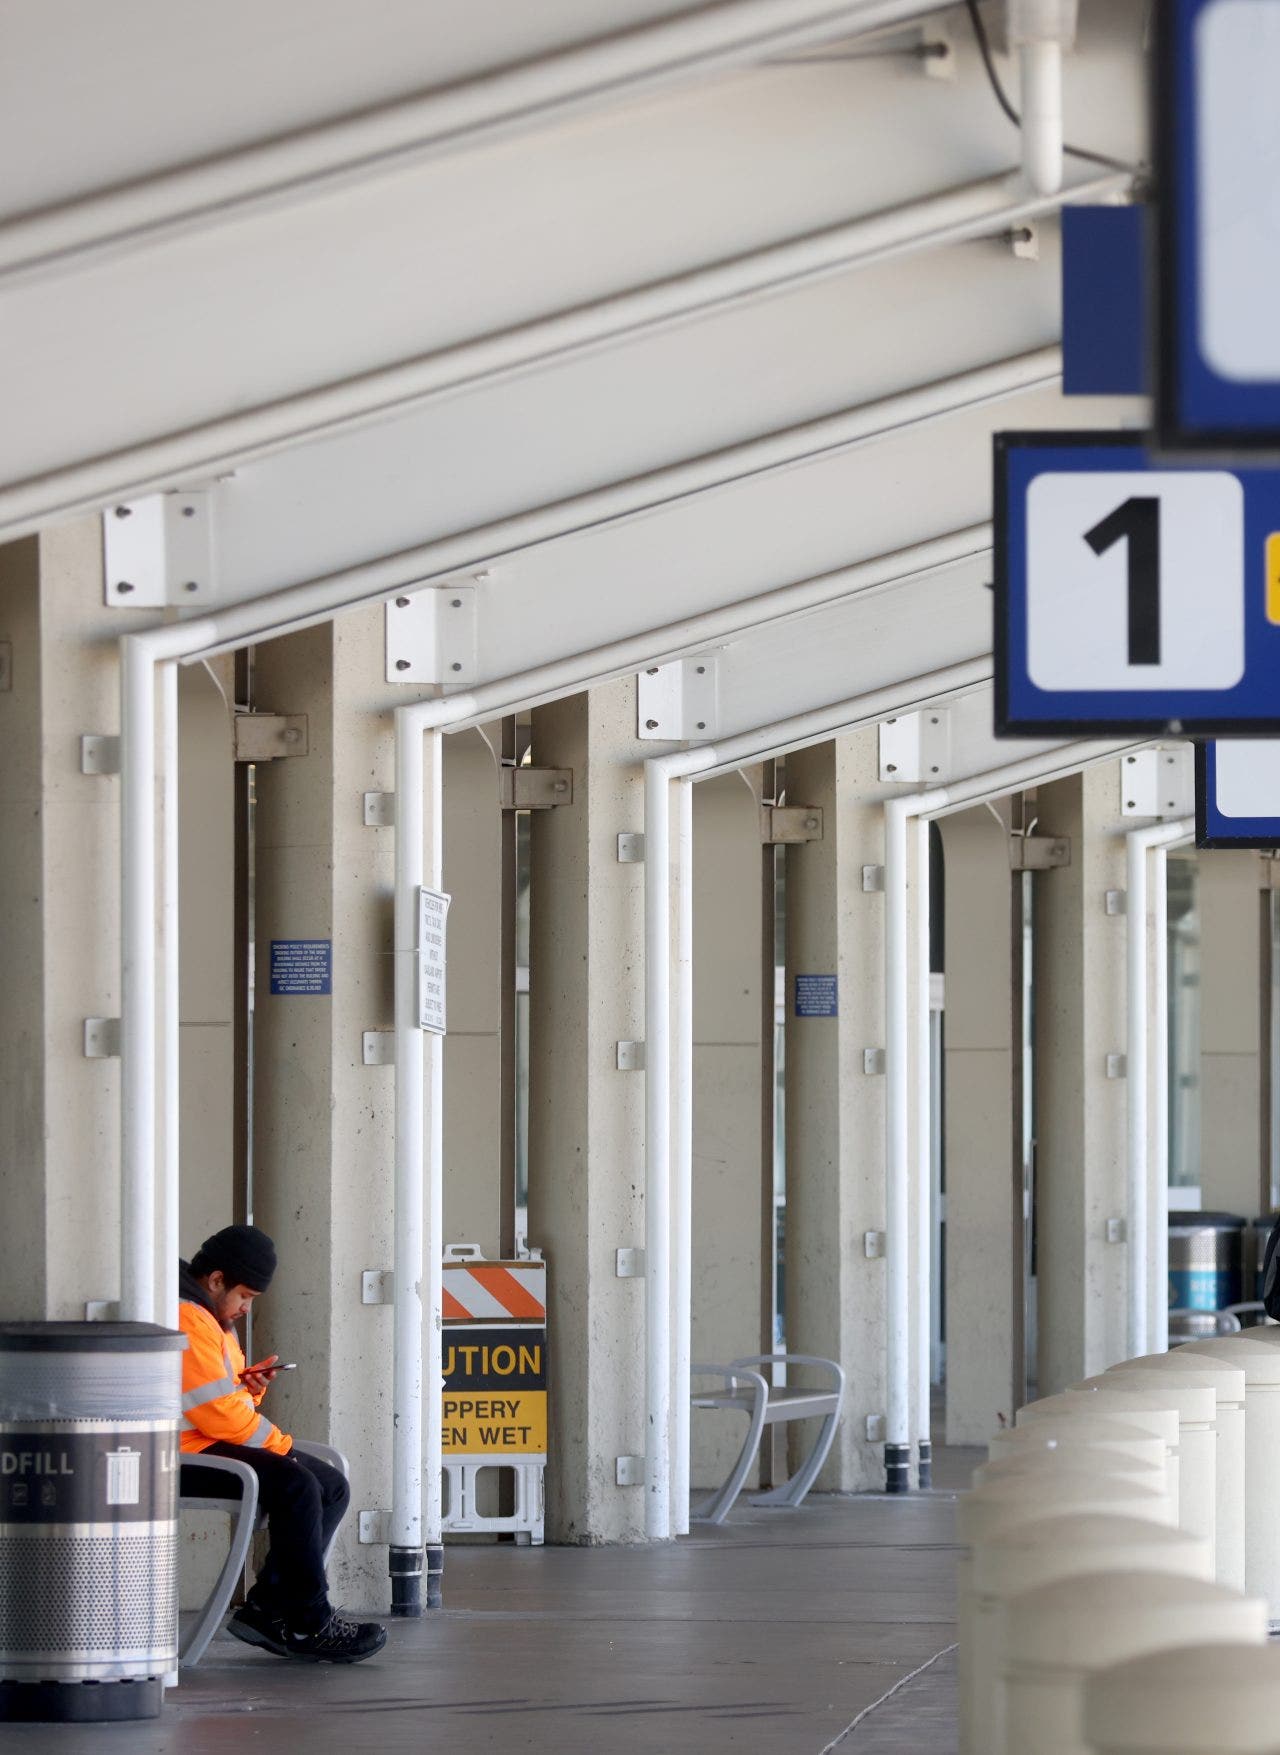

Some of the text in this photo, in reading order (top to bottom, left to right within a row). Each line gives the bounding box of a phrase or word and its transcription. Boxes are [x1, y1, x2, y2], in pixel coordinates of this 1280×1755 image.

[1083, 498, 1160, 666] 1
[442, 1345, 541, 1376] UTION
[444, 1400, 521, 1419] PPERY
[479, 1426, 532, 1445] WET
[2, 1452, 74, 1475] DFILL
